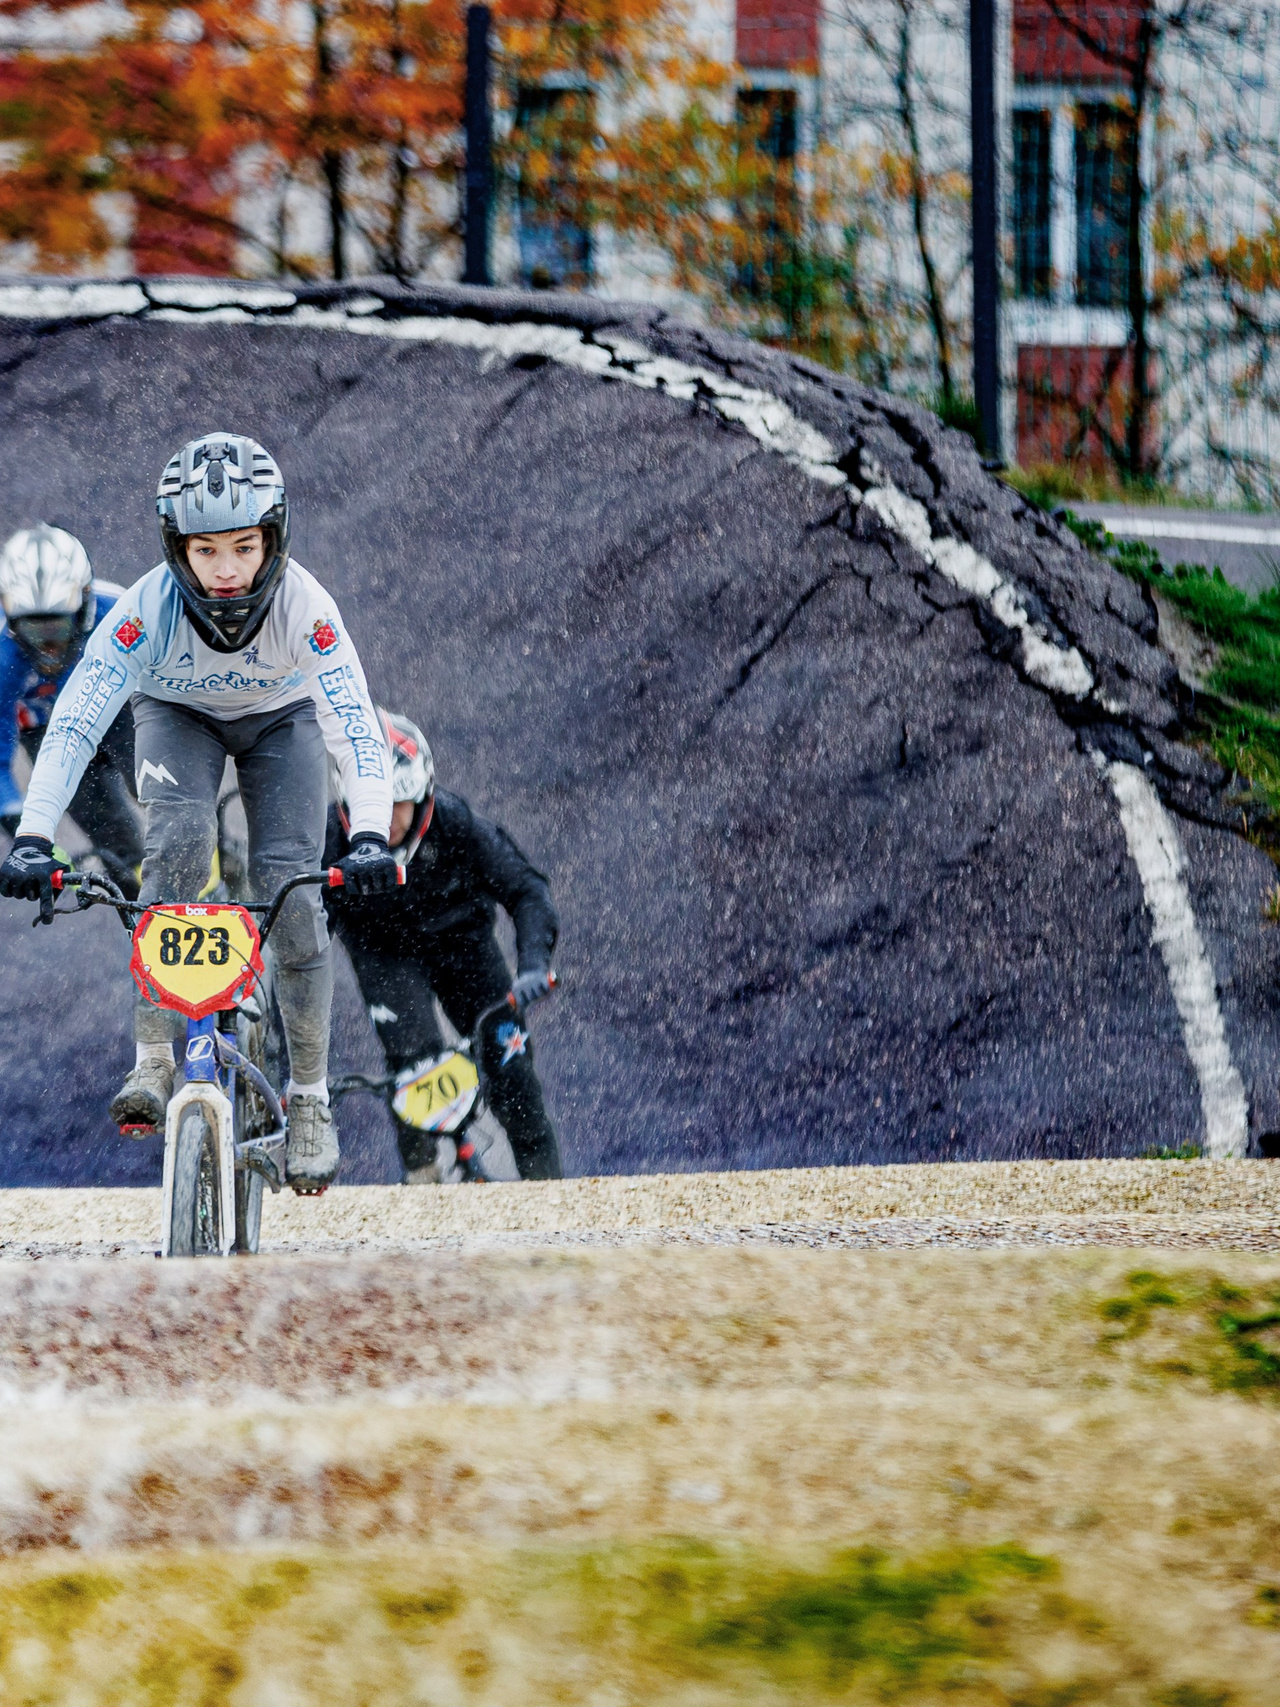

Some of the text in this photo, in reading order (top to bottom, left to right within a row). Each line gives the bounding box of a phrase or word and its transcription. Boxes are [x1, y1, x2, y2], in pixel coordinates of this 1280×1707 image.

[185, 905, 208, 916] box
[160, 927, 230, 966] 823
[416, 1072, 459, 1112] 70
